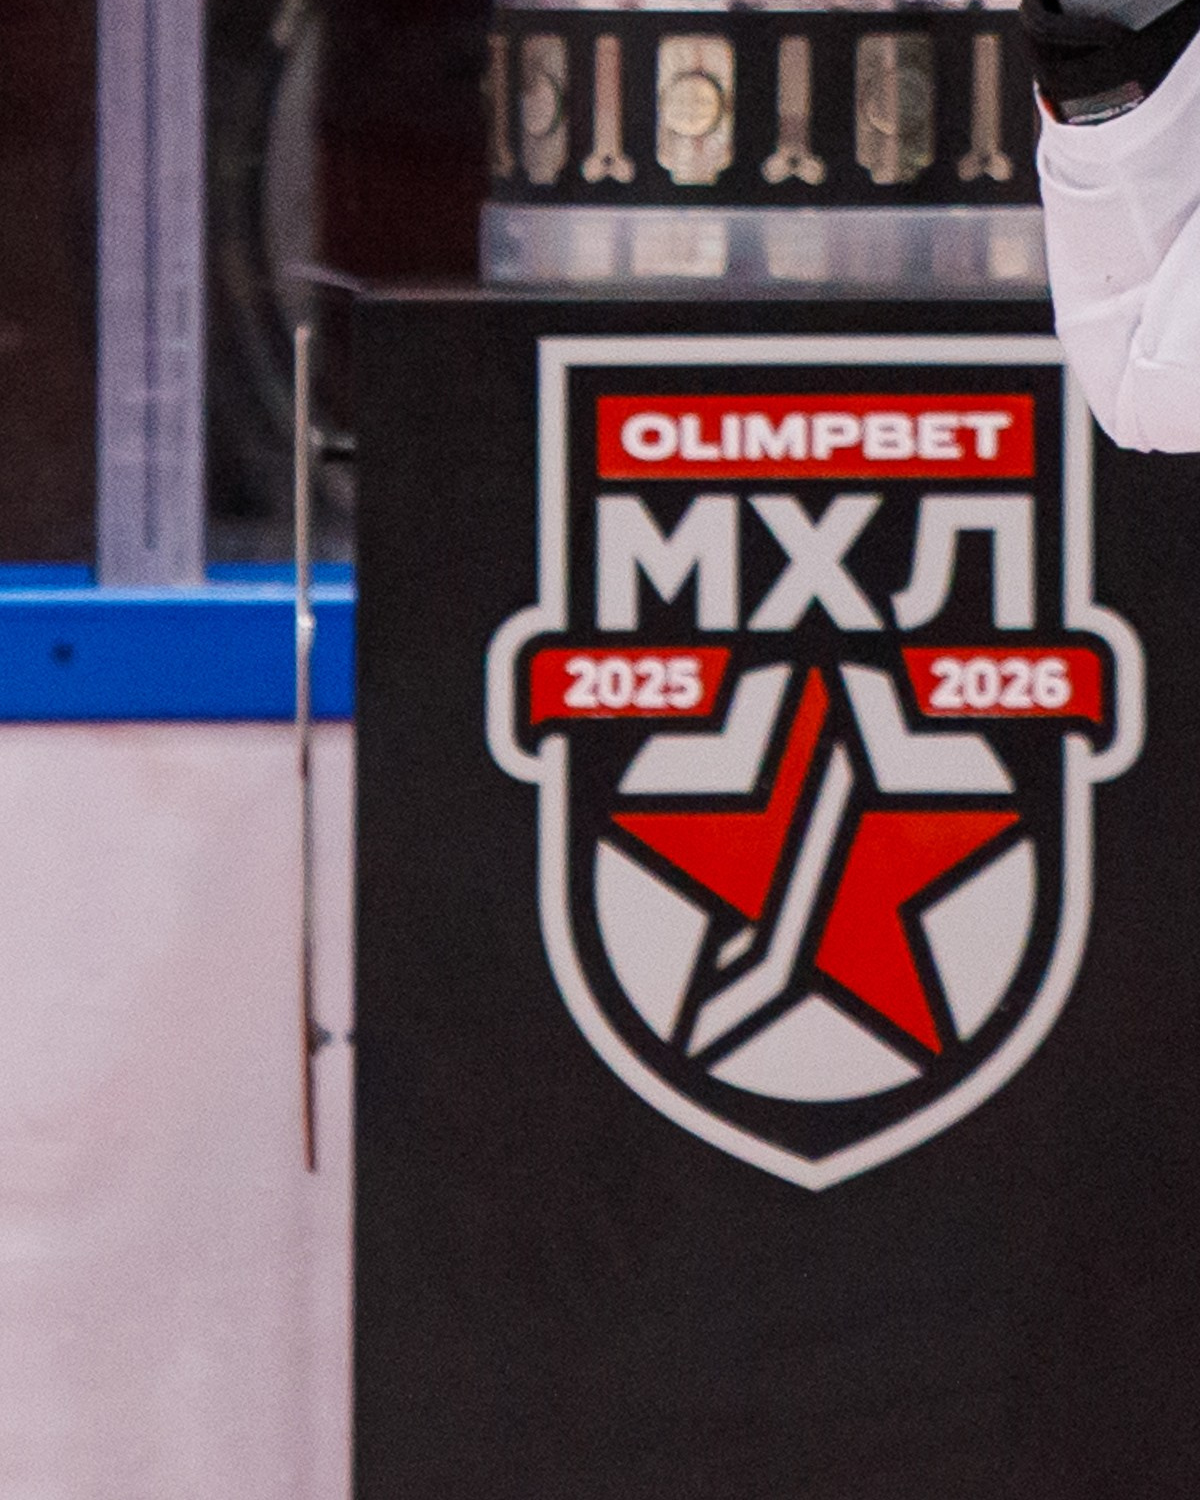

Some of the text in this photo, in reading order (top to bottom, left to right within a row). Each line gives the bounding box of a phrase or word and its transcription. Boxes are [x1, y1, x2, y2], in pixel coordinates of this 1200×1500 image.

[620, 411, 1013, 462] OLIMPBET
[595, 493, 1036, 631] МХЛ
[563, 657, 1070, 710] 2025 2026
